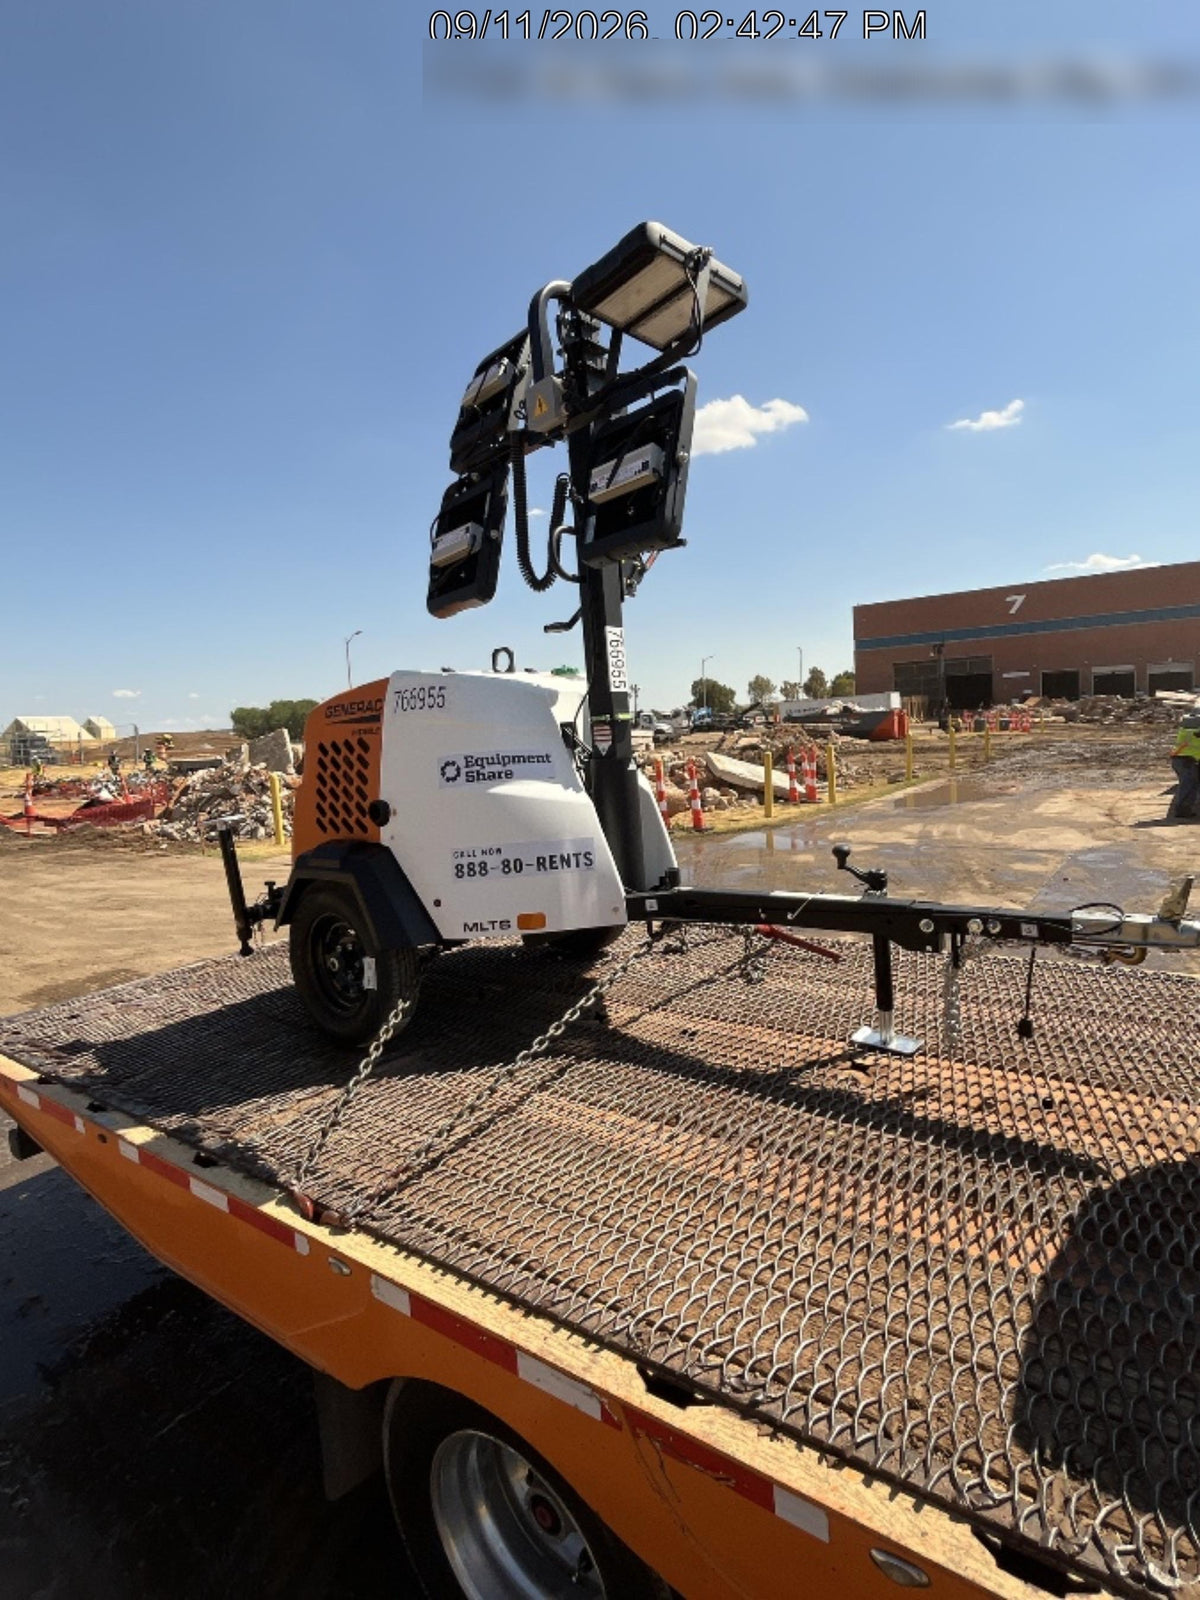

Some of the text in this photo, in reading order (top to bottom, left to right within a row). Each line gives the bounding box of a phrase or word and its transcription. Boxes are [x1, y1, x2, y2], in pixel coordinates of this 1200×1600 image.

[1005, 594, 1027, 614] 7
[607, 629, 627, 689] 766955
[463, 753, 552, 769] Equipment
[464, 769, 514, 783] Share
[454, 851, 593, 879] 888-80-RENTS
